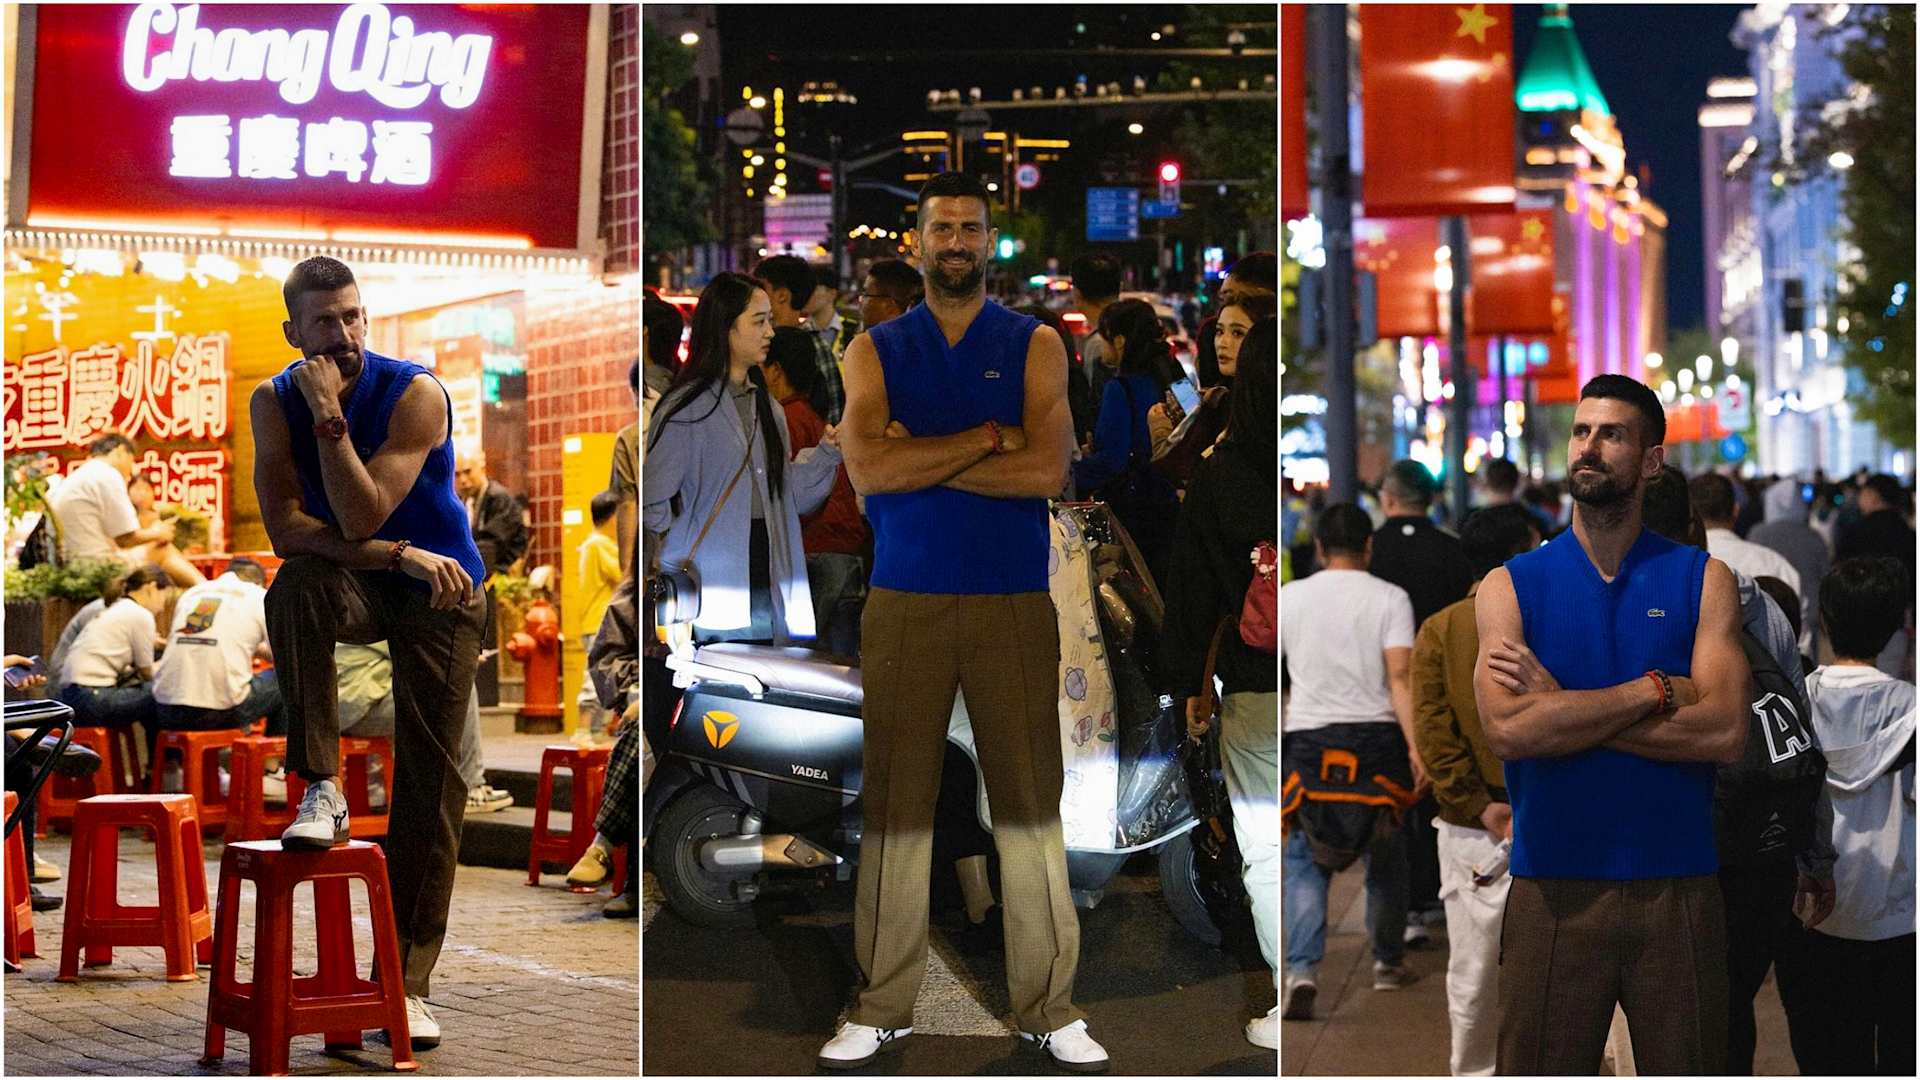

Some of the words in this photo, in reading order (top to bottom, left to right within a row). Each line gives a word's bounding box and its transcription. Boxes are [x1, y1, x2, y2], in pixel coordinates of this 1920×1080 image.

[124, 4, 329, 103] Chong
[329, 4, 493, 108] Qing
[1752, 691, 1812, 764] A
[791, 764, 829, 781] YADEA
